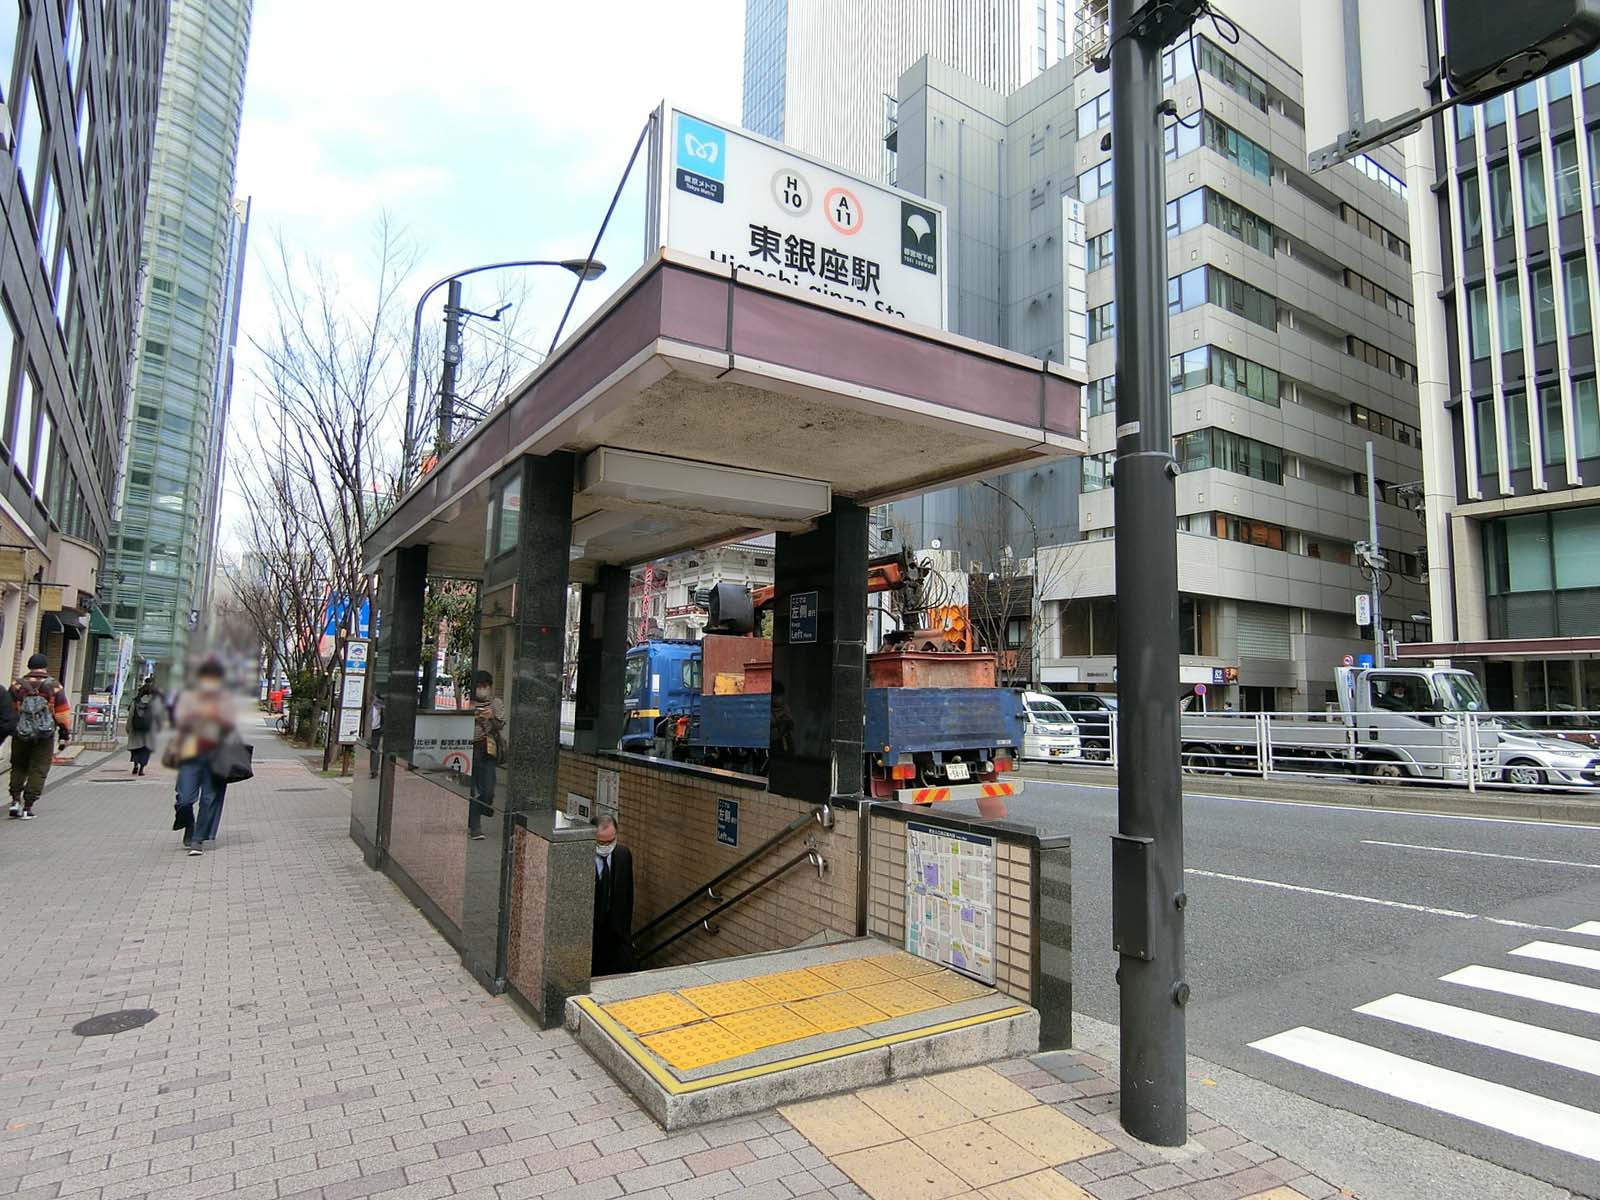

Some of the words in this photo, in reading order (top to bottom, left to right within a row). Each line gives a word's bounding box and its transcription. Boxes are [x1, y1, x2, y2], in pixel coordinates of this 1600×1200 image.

[786, 176, 798, 191] H
[783, 189, 802, 208] 10
[839, 196, 849, 210] A
[835, 208, 851, 226] 11
[748, 223, 881, 295] 東銀座駅
[453, 757, 461, 765] A
